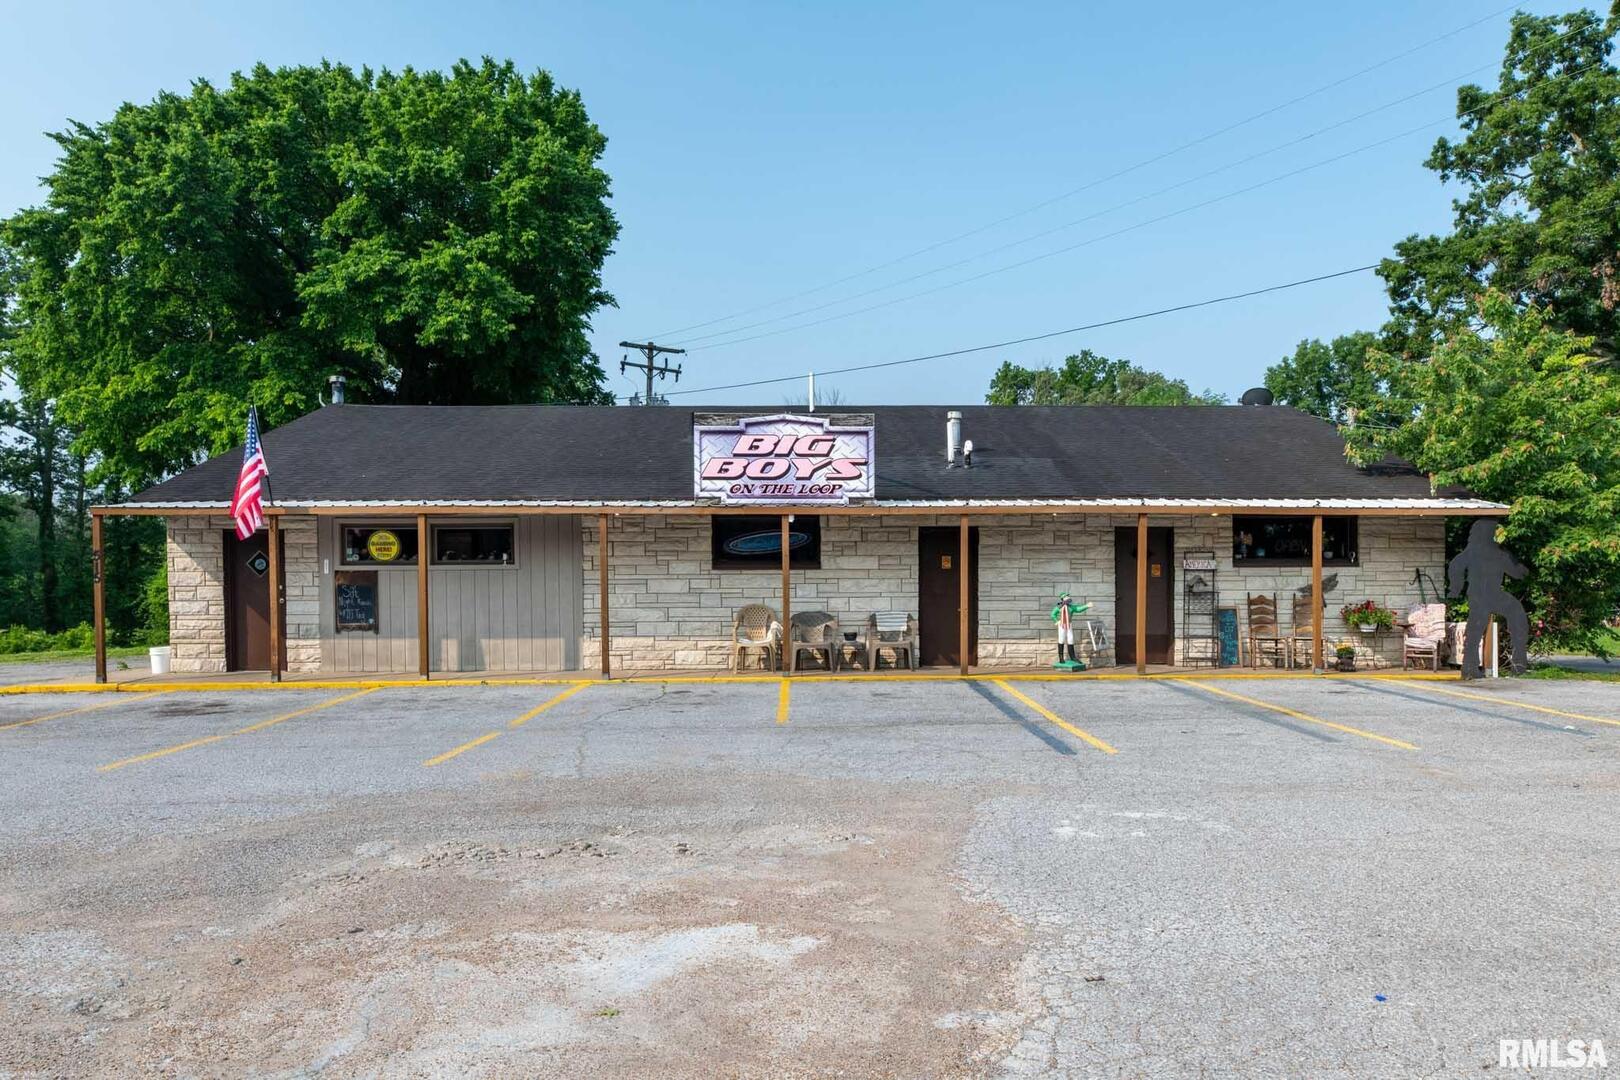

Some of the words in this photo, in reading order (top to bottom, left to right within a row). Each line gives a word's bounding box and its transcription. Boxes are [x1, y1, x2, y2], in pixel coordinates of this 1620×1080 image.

[731, 434, 836, 457] BIG
[701, 456, 868, 481] BOYS
[729, 484, 755, 494] ON
[758, 484, 794, 494] THE
[798, 484, 843, 494] LOOP
